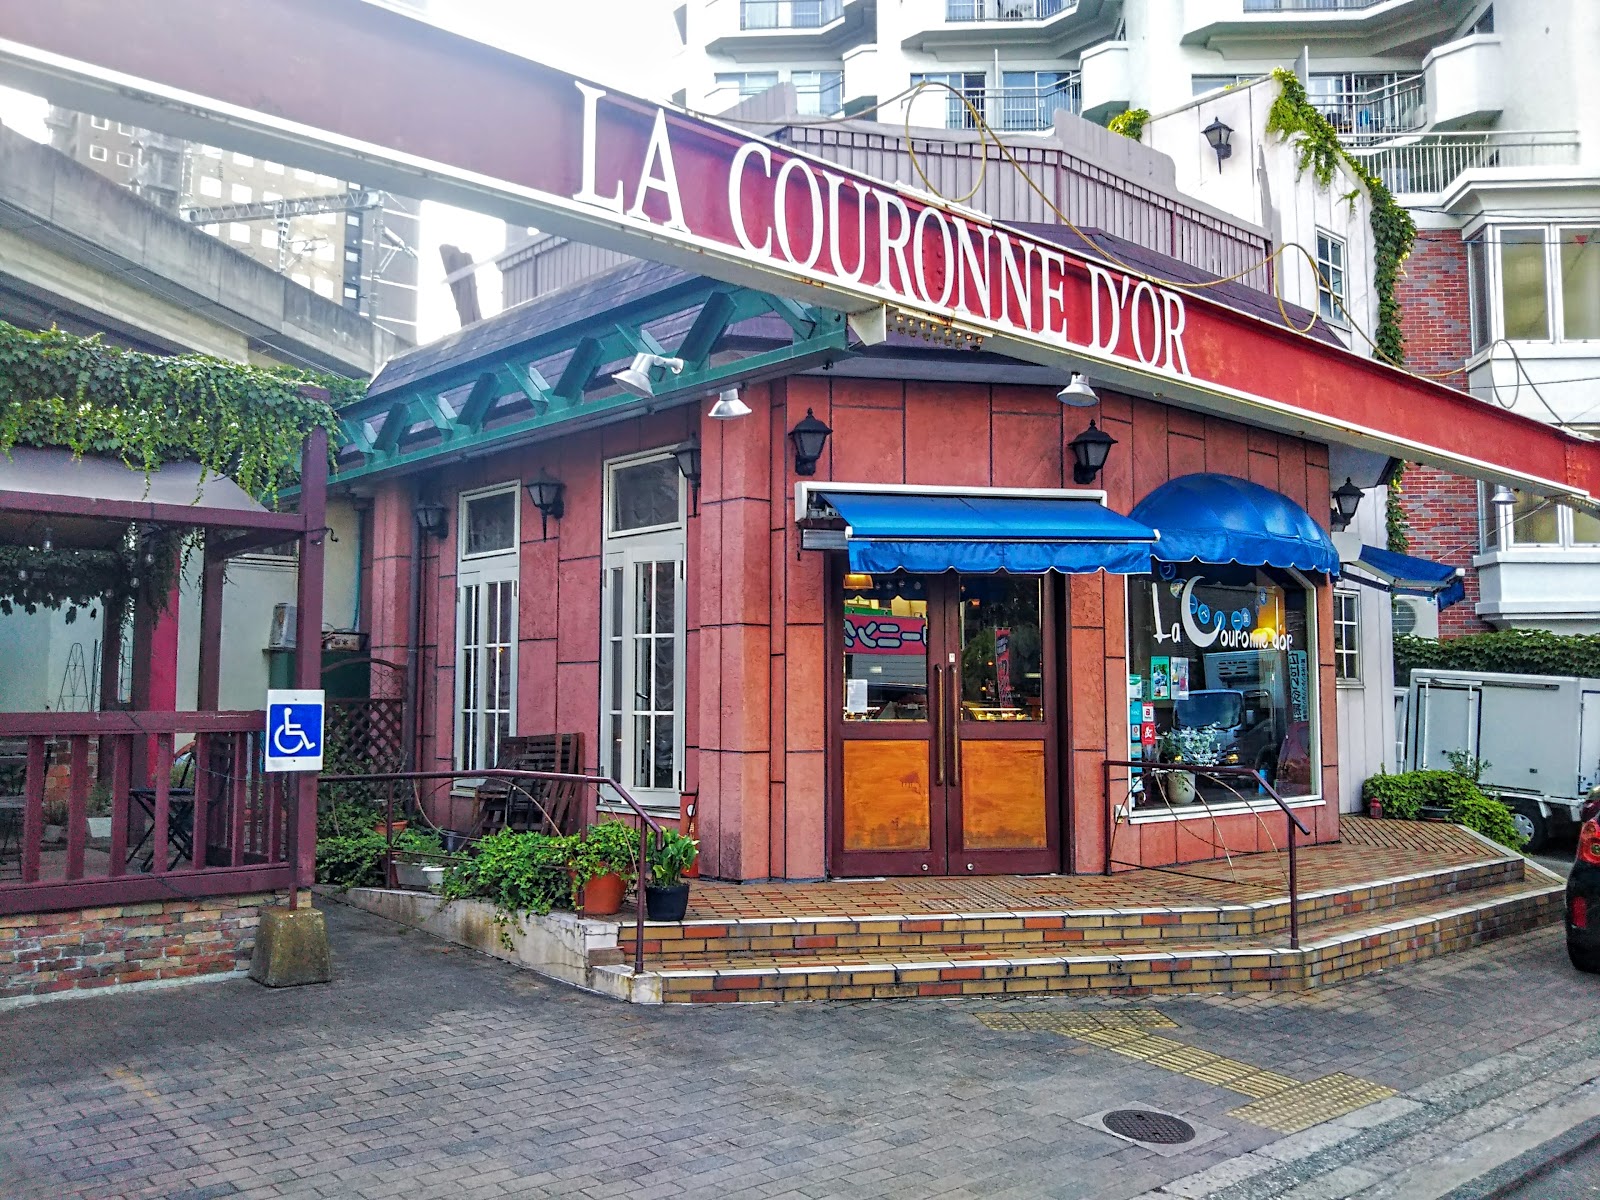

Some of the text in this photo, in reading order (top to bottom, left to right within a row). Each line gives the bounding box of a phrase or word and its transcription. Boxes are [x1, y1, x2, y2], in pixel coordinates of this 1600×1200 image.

[572, 80, 1191, 378] LA COURONNE D'OR
[1152, 582, 1181, 644] La
[1181, 575, 1269, 649] Couronne
